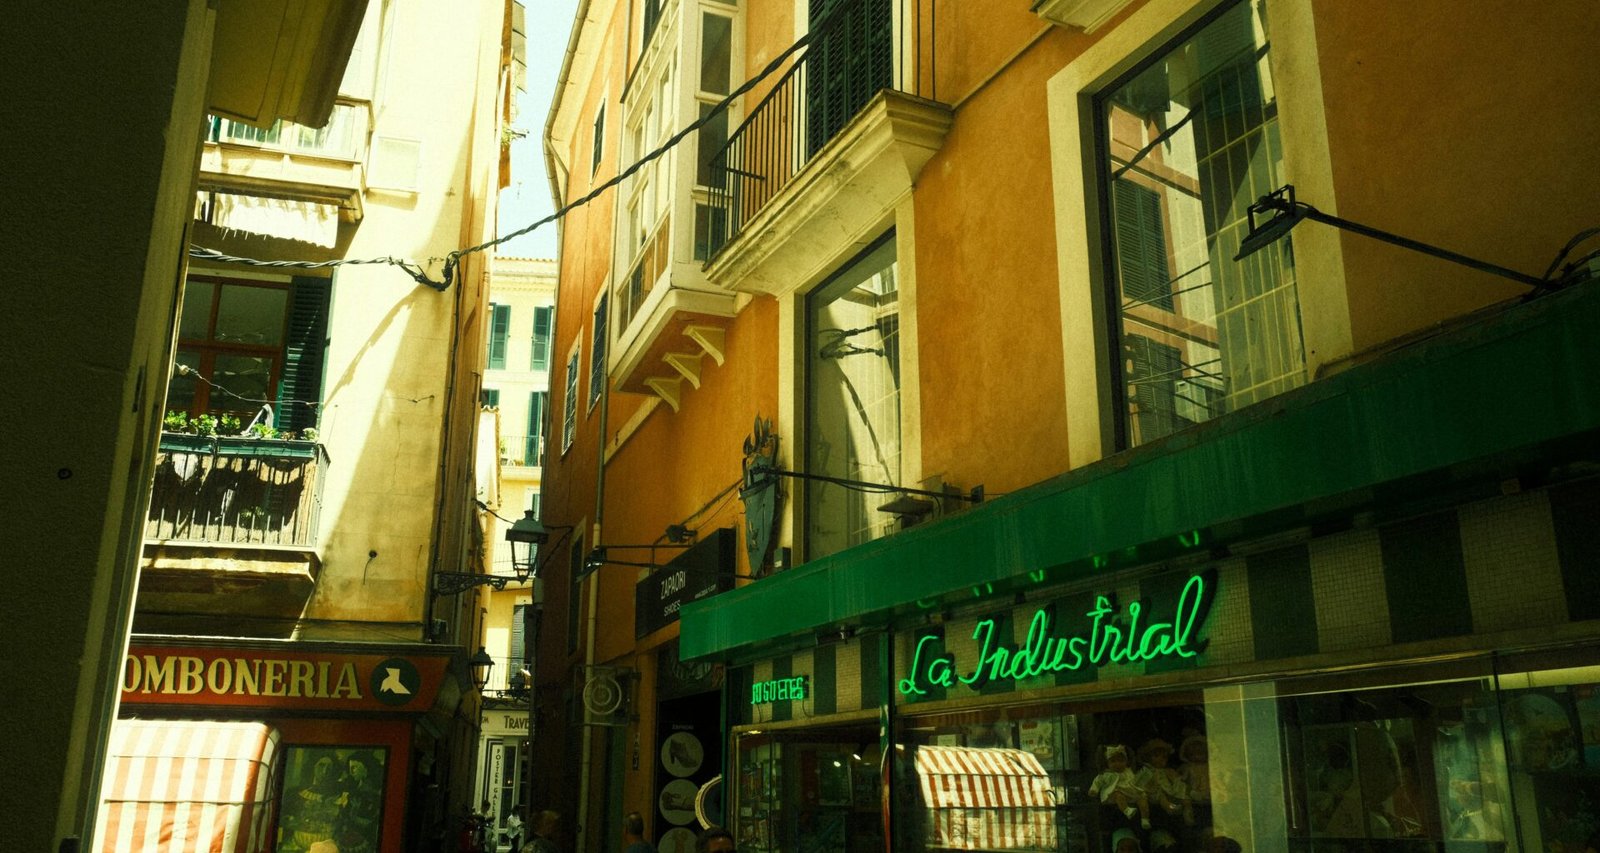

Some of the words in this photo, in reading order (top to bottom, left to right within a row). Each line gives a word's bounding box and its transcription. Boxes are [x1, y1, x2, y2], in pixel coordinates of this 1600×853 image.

[660, 570, 686, 600] ZAPAORI
[663, 599, 681, 617] SHOES
[899, 636, 952, 694] La
[958, 576, 1203, 684] Industrial
[494, 748, 502, 784] POSTER
